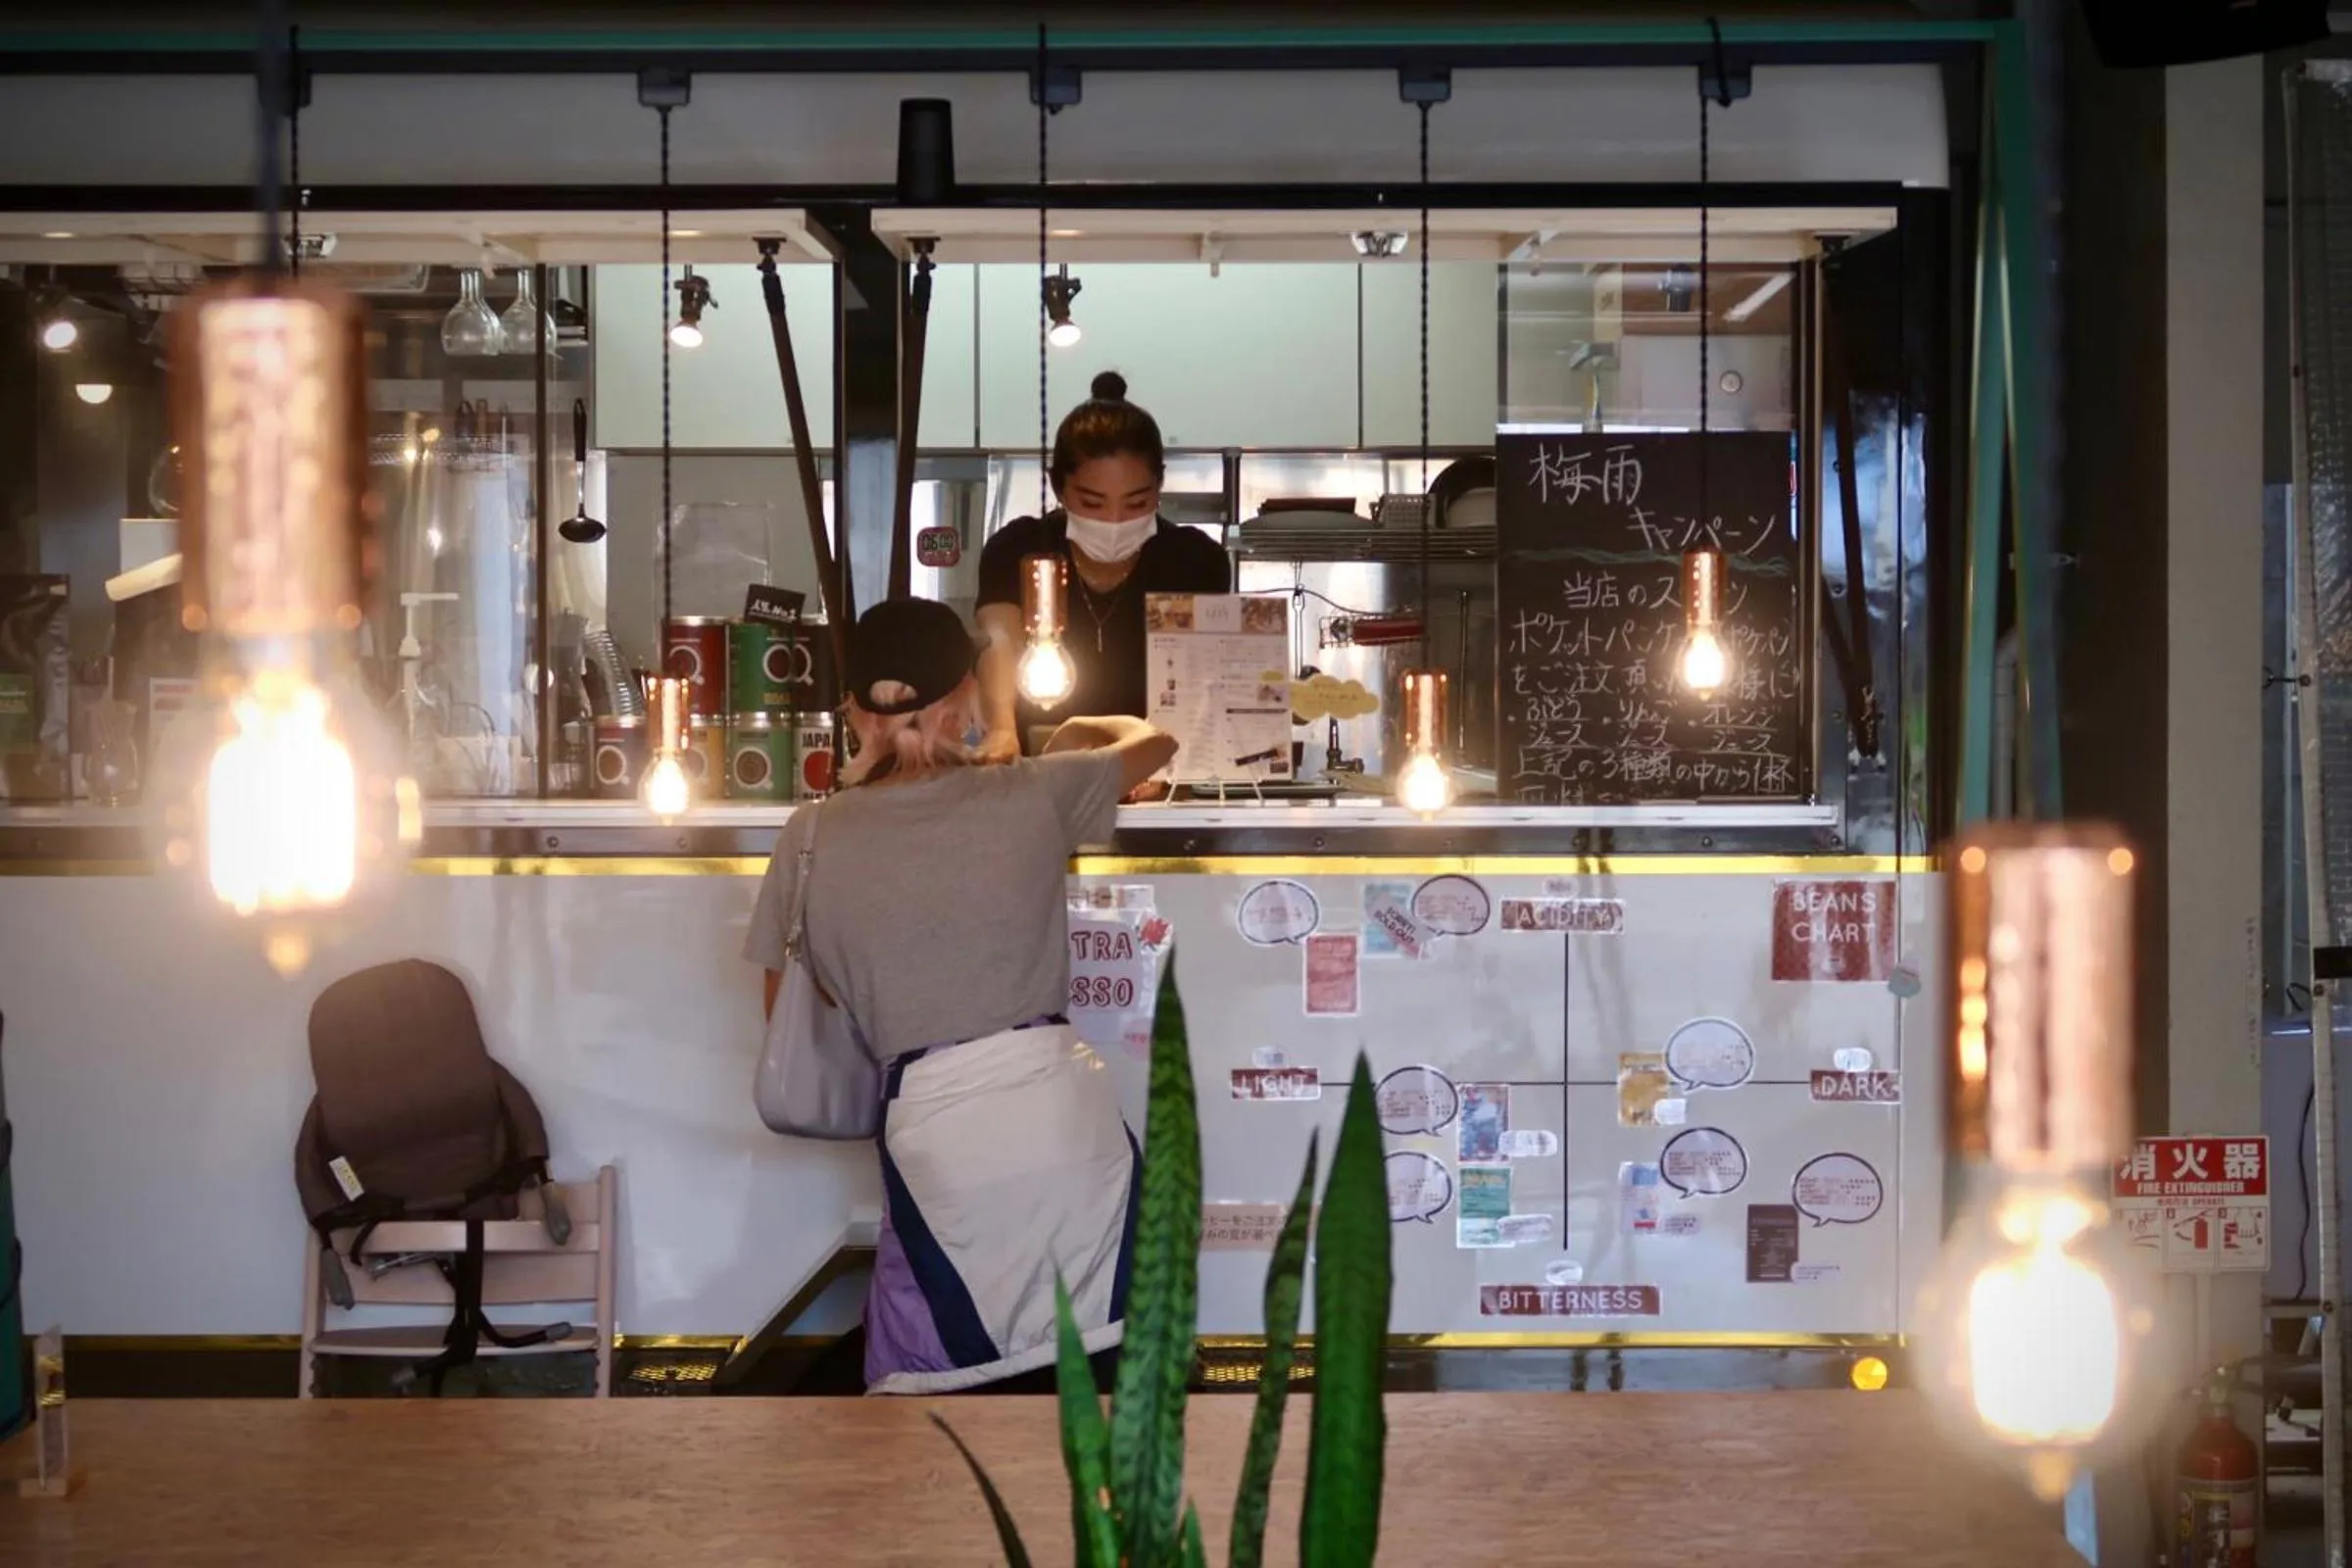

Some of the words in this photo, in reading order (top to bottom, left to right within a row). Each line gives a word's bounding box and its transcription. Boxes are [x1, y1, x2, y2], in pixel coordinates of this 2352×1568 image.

[1529, 443, 1642, 505] 梅雨
[1627, 507, 1775, 555] キャンパーン
[1792, 891, 1876, 913] BEANS
[1518, 906, 1610, 926] ACIDITY
[1070, 931, 1133, 960] TRA
[1791, 921, 1876, 943] CHART
[1070, 976, 1134, 1007] SSO
[1821, 1073, 1891, 1099] DARK
[2120, 1143, 2261, 1180] 消火器
[1499, 1291, 1642, 1310] BITTERNESS
